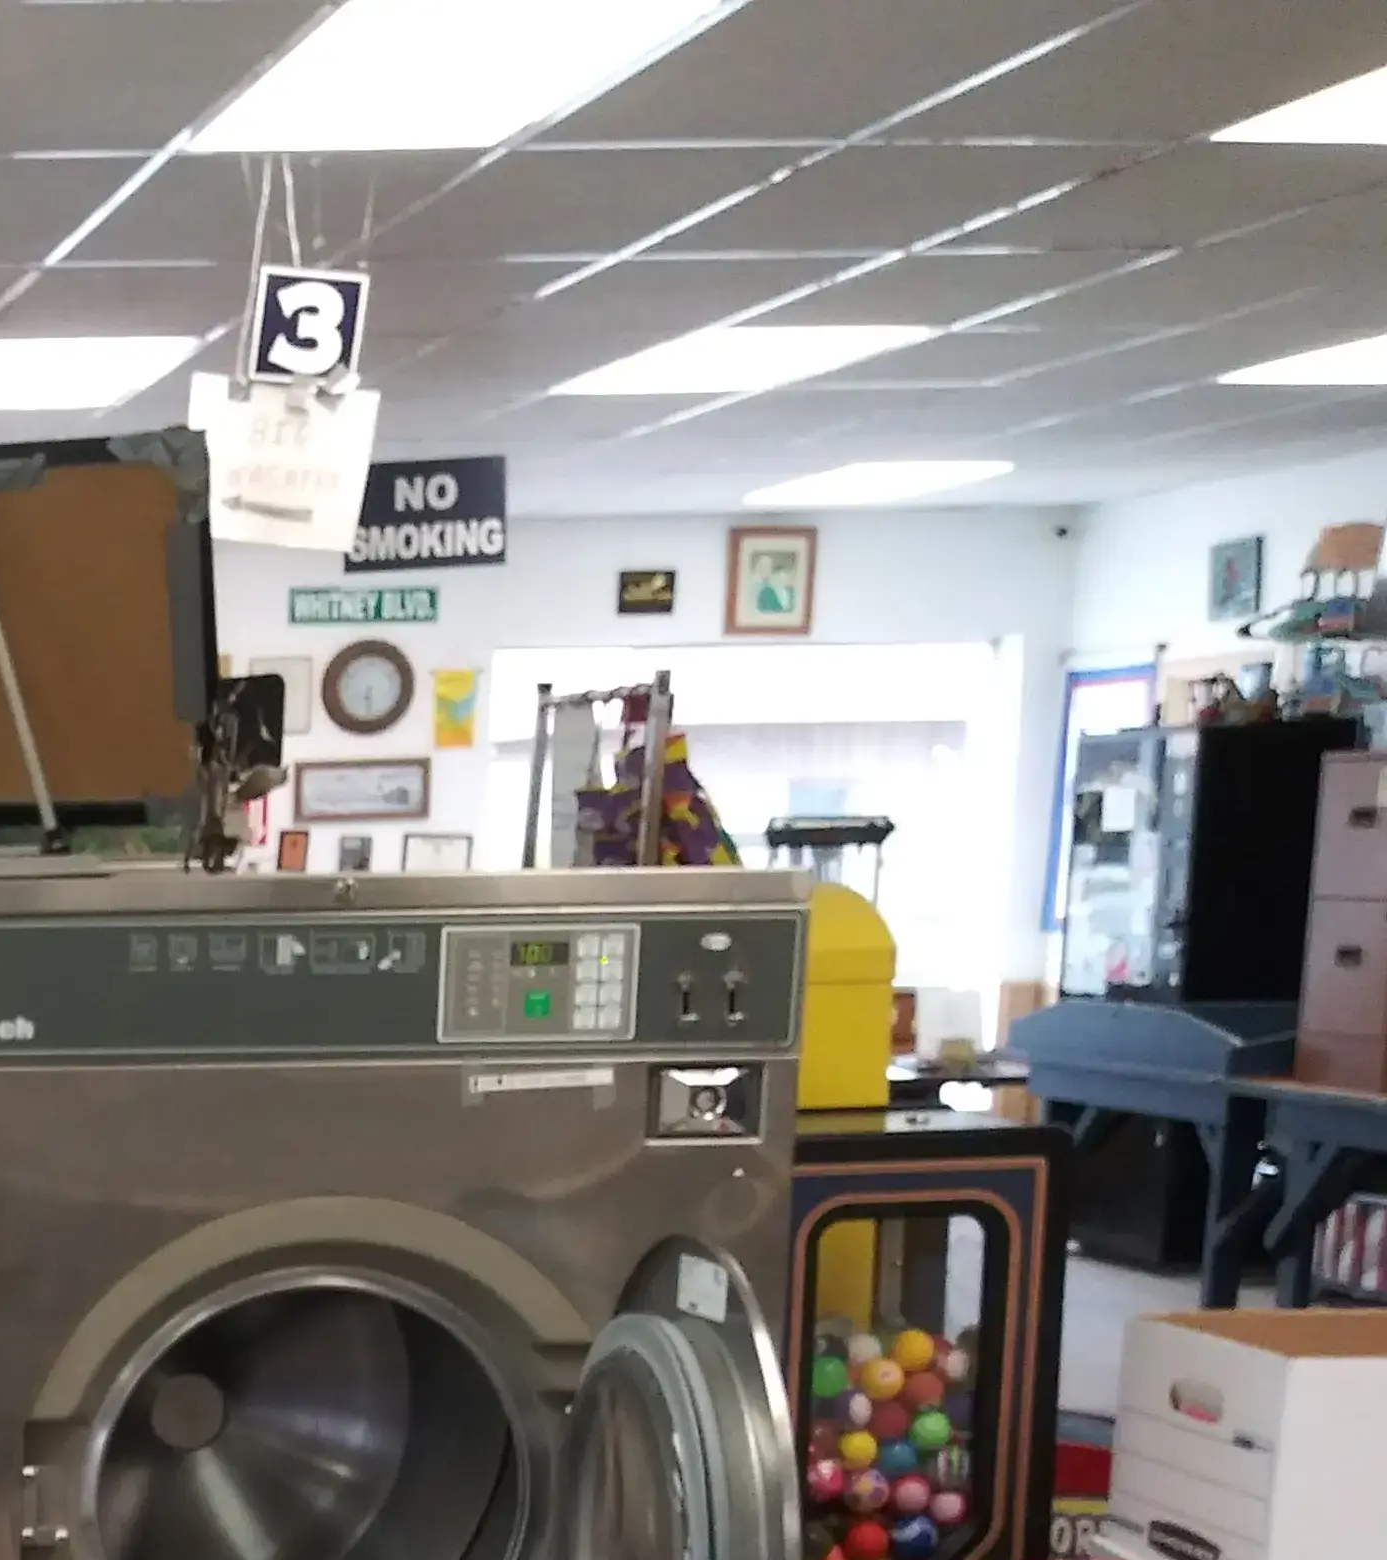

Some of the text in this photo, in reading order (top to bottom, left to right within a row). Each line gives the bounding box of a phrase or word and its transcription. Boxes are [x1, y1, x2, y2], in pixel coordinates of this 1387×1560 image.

[267, 281, 345, 375] 3
[393, 472, 460, 512] NO
[348, 516, 505, 563] SMOKING
